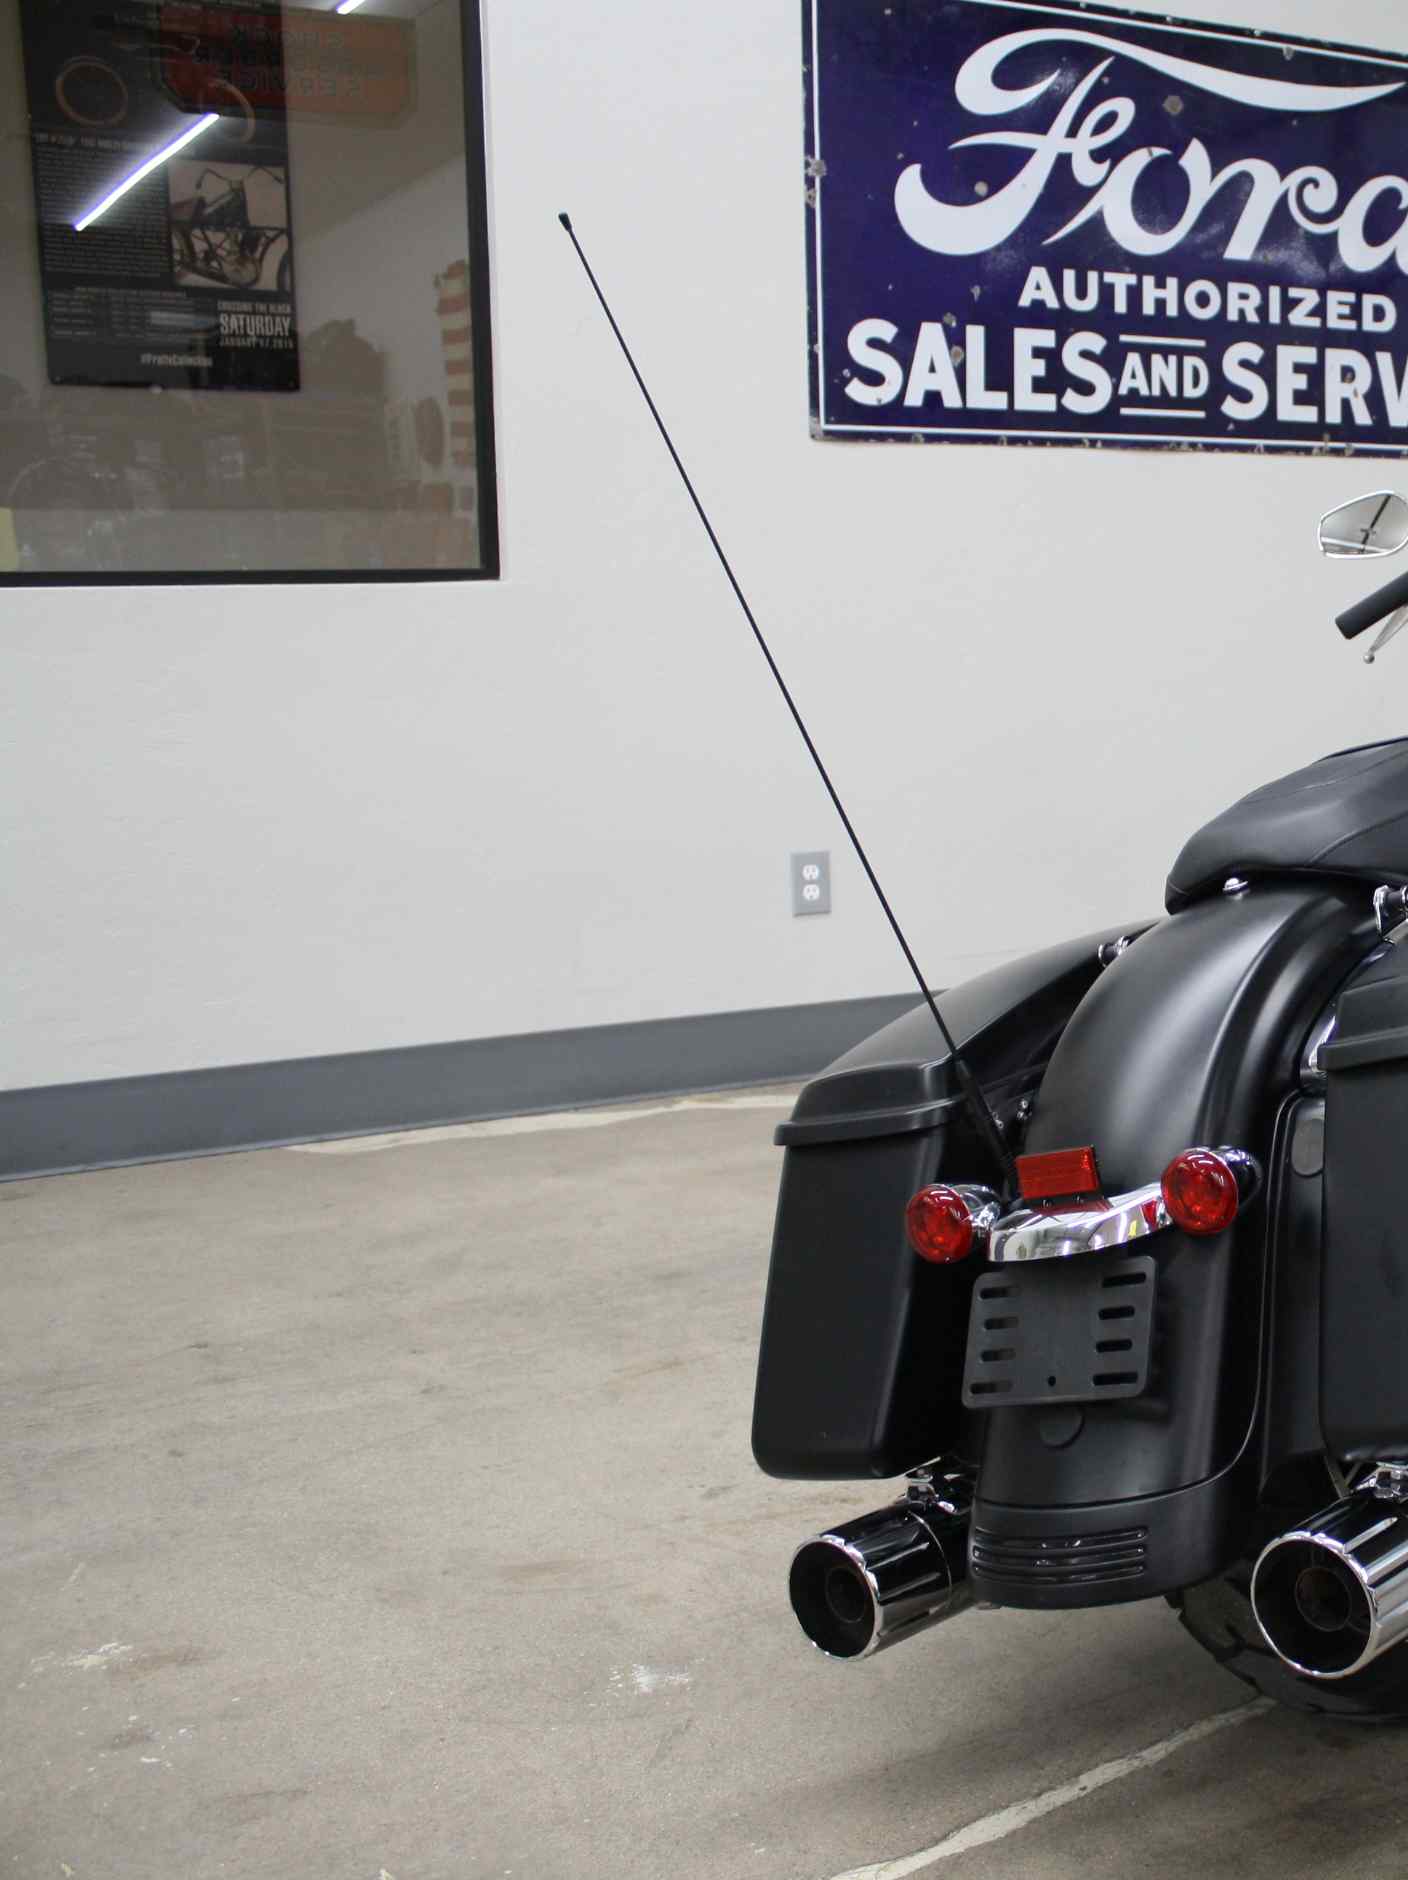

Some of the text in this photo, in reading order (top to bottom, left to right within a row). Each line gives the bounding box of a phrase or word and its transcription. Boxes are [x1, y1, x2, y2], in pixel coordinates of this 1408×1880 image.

[219, 313, 291, 337] SATURDAY
[1018, 265, 1397, 333] AUTHORIZED
[844, 317, 1113, 416] SALES
[1118, 351, 1210, 399] AND
